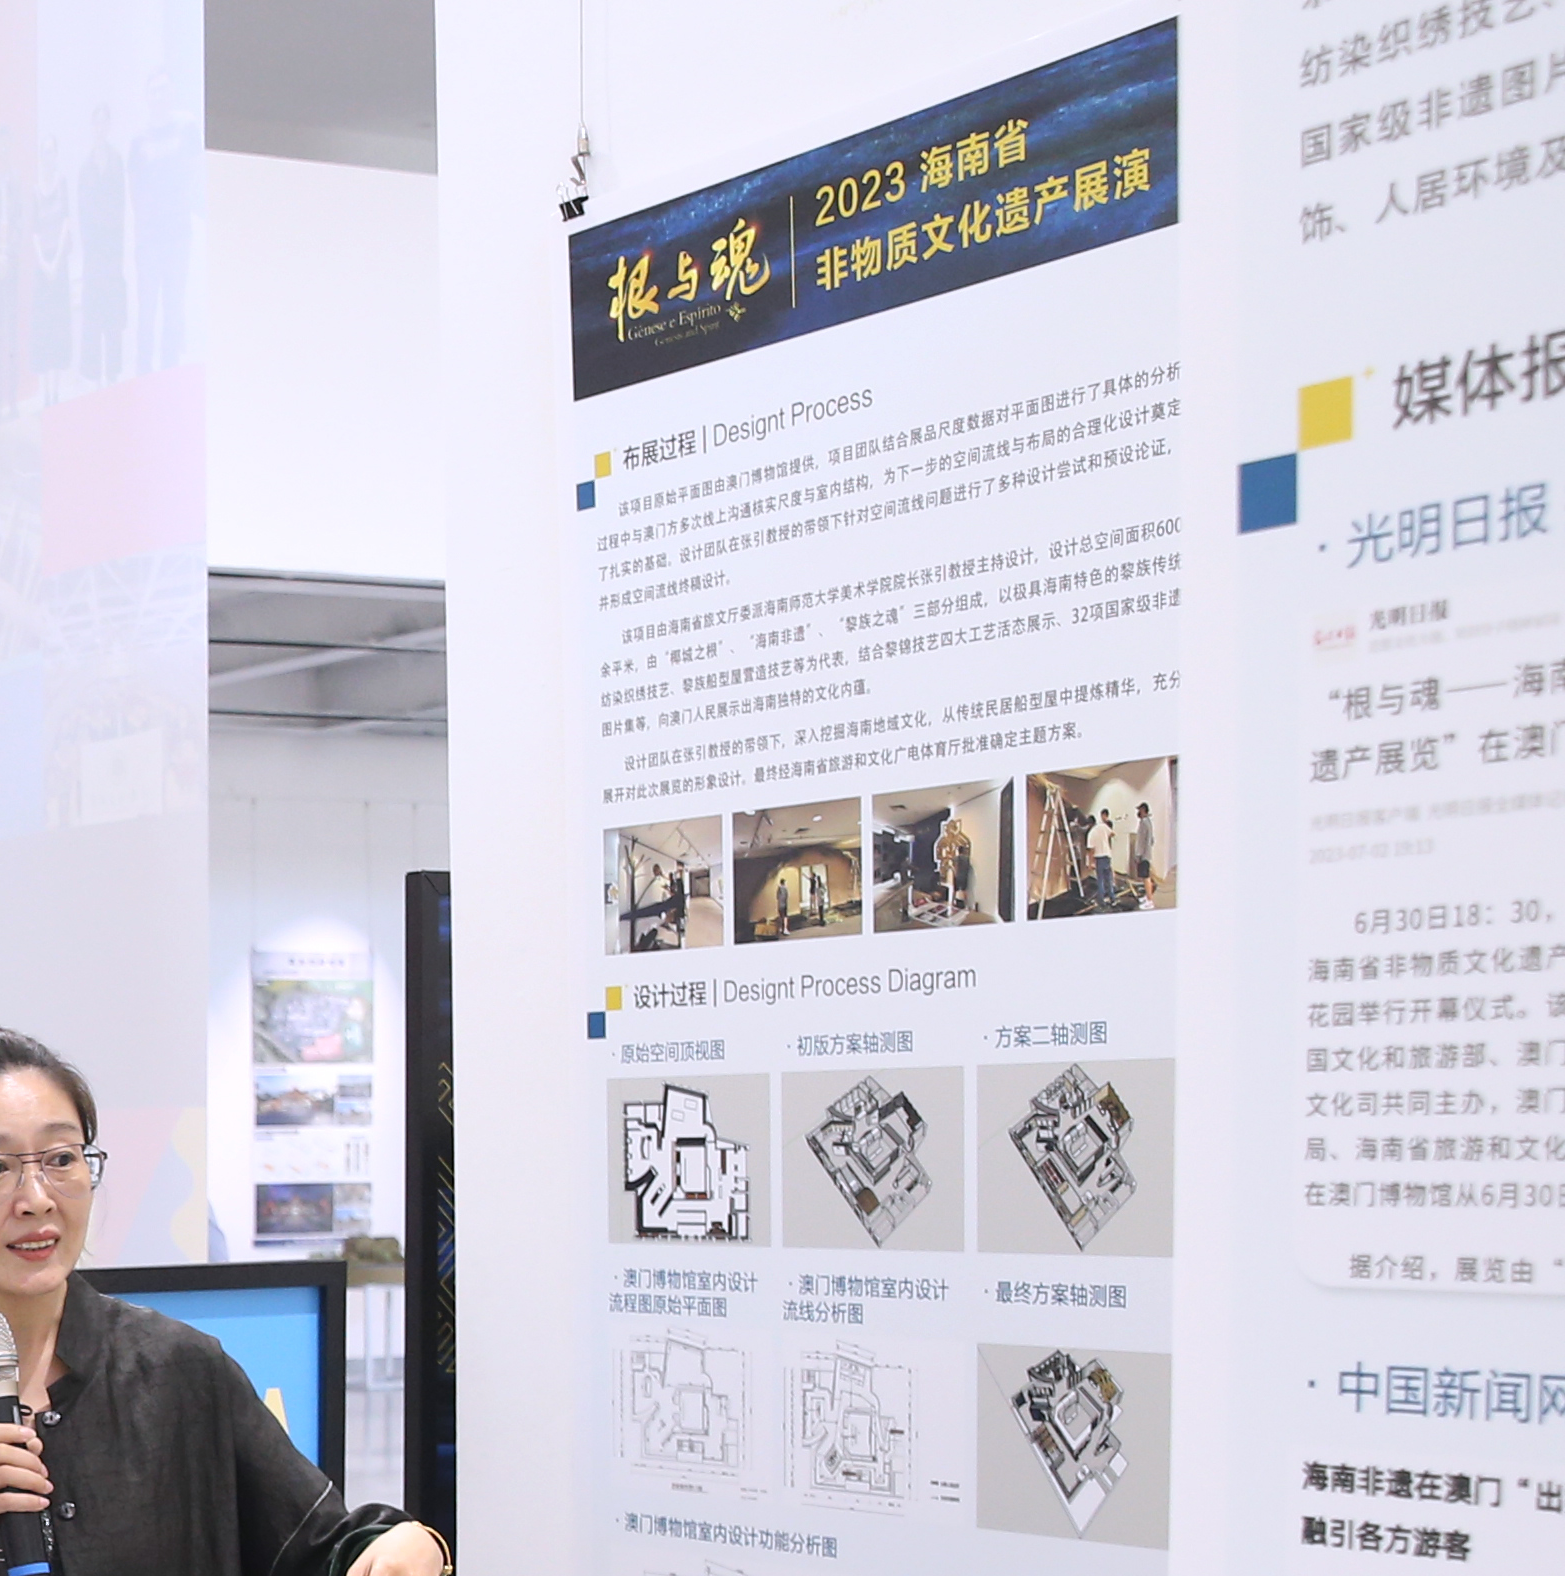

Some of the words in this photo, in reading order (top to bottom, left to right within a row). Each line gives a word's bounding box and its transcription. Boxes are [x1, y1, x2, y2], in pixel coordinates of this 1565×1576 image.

[814, 165, 906, 227] 2023
[921, 118, 1030, 192] 海南省
[815, 147, 1152, 291] 非物质文化遗产展演
[607, 217, 772, 343] 根与魂
[622, 429, 697, 471] 布展过程
[713, 407, 786, 448] Designt
[791, 388, 874, 427] Process
[1346, 482, 1548, 570] 光明日报
[1369, 598, 1448, 632] 光明日报
[632, 981, 707, 1010] 设计过程
[723, 977, 797, 1006] Designt
[800, 971, 883, 1000] Process
[888, 965, 977, 995] Diagram
[796, 1030, 914, 1057] 初版方案轴测图
[994, 1020, 1108, 1049] 方案二轴测图
[620, 1038, 726, 1065] 原始空间顶视图
[622, 1267, 759, 1295] 澳门博物馆室内设计
[797, 1272, 950, 1303] 澳门博物馆室内设计
[994, 1280, 1128, 1310] 最终方案轴测图
[608, 1293, 728, 1319] 流程图原始平面图
[781, 1298, 865, 1327] 流线分析图
[623, 1510, 838, 1560] 澳门博物馆室内设计功能分析图
